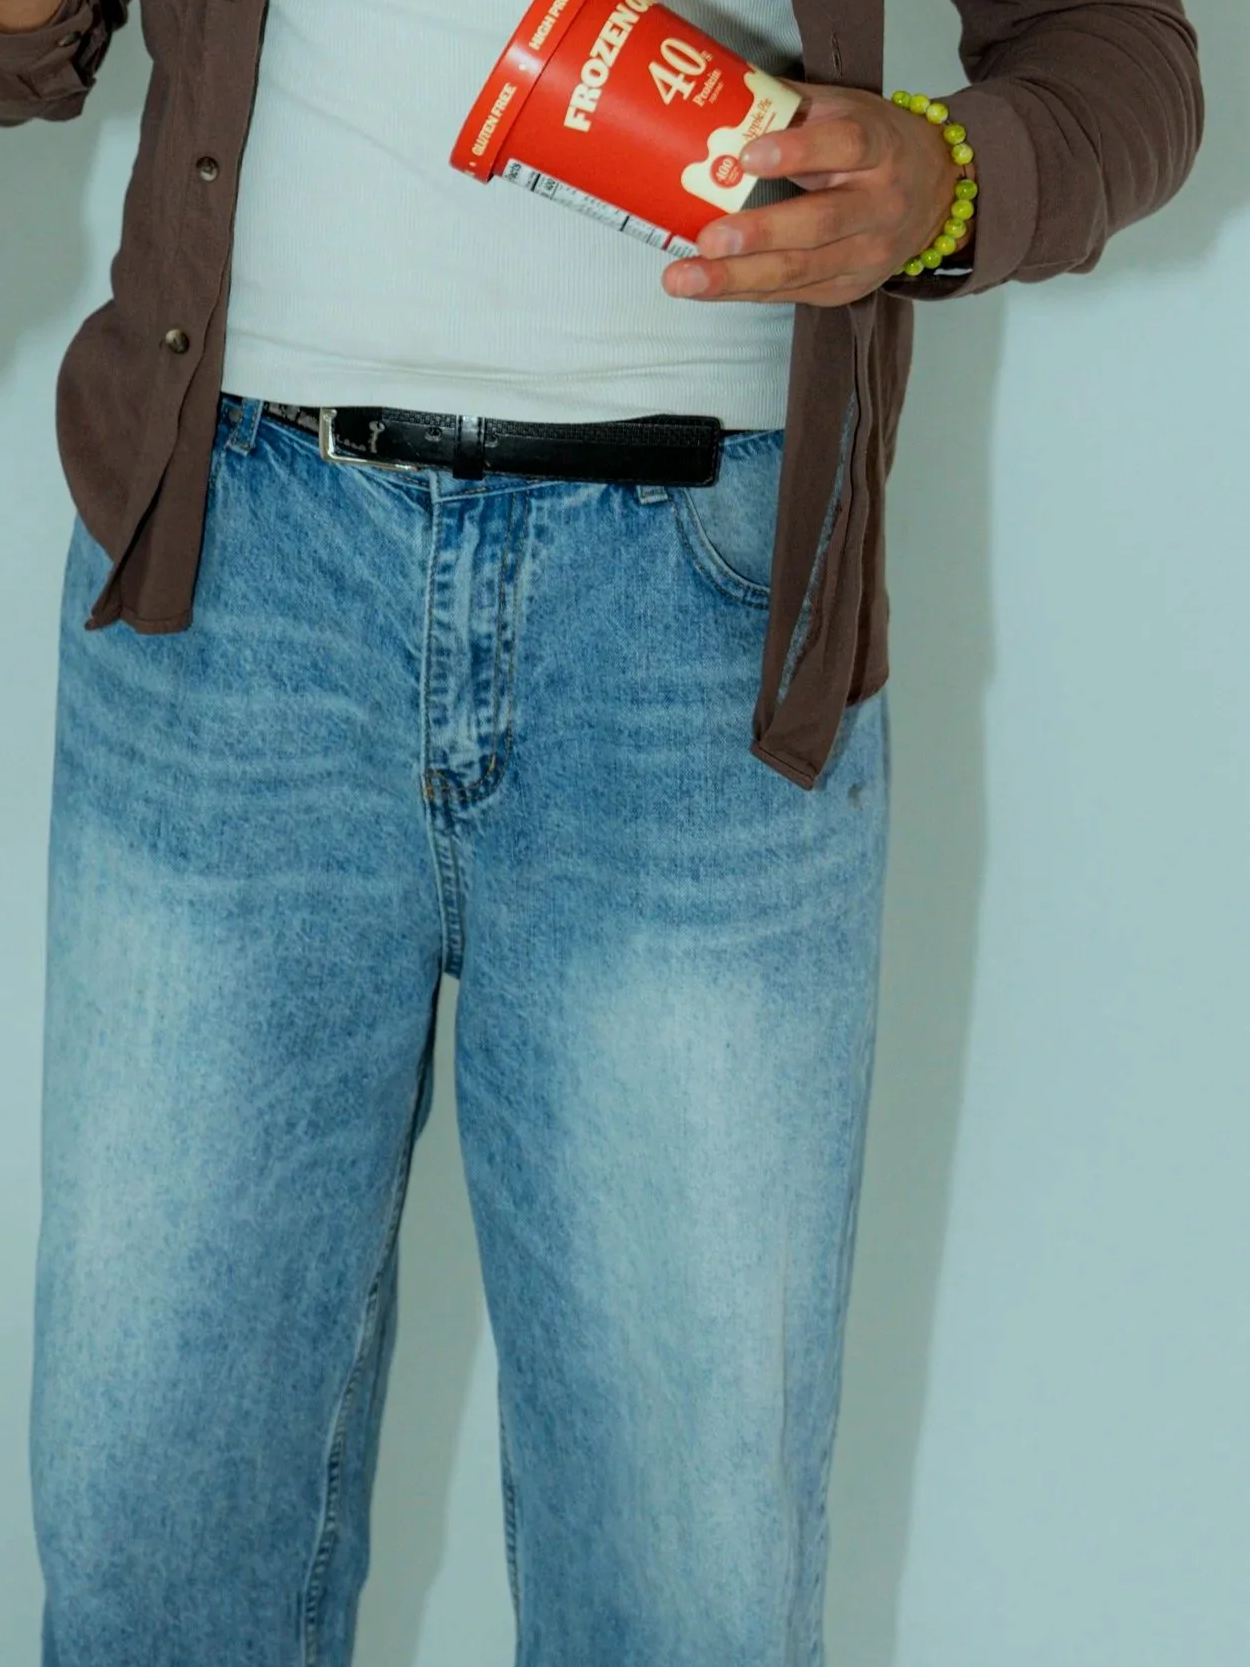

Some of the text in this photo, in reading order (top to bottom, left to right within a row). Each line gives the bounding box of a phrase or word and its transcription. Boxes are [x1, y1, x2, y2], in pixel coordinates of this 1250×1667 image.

[471, 114, 498, 156] GLUTEN
[492, 82, 518, 117] FREE
[529, 13, 555, 51] HIGH
[563, 3, 640, 133] FROZEN
[692, 68, 722, 108] Protein
[742, 112, 765, 141] Apple
[757, 97, 773, 112] Pie
